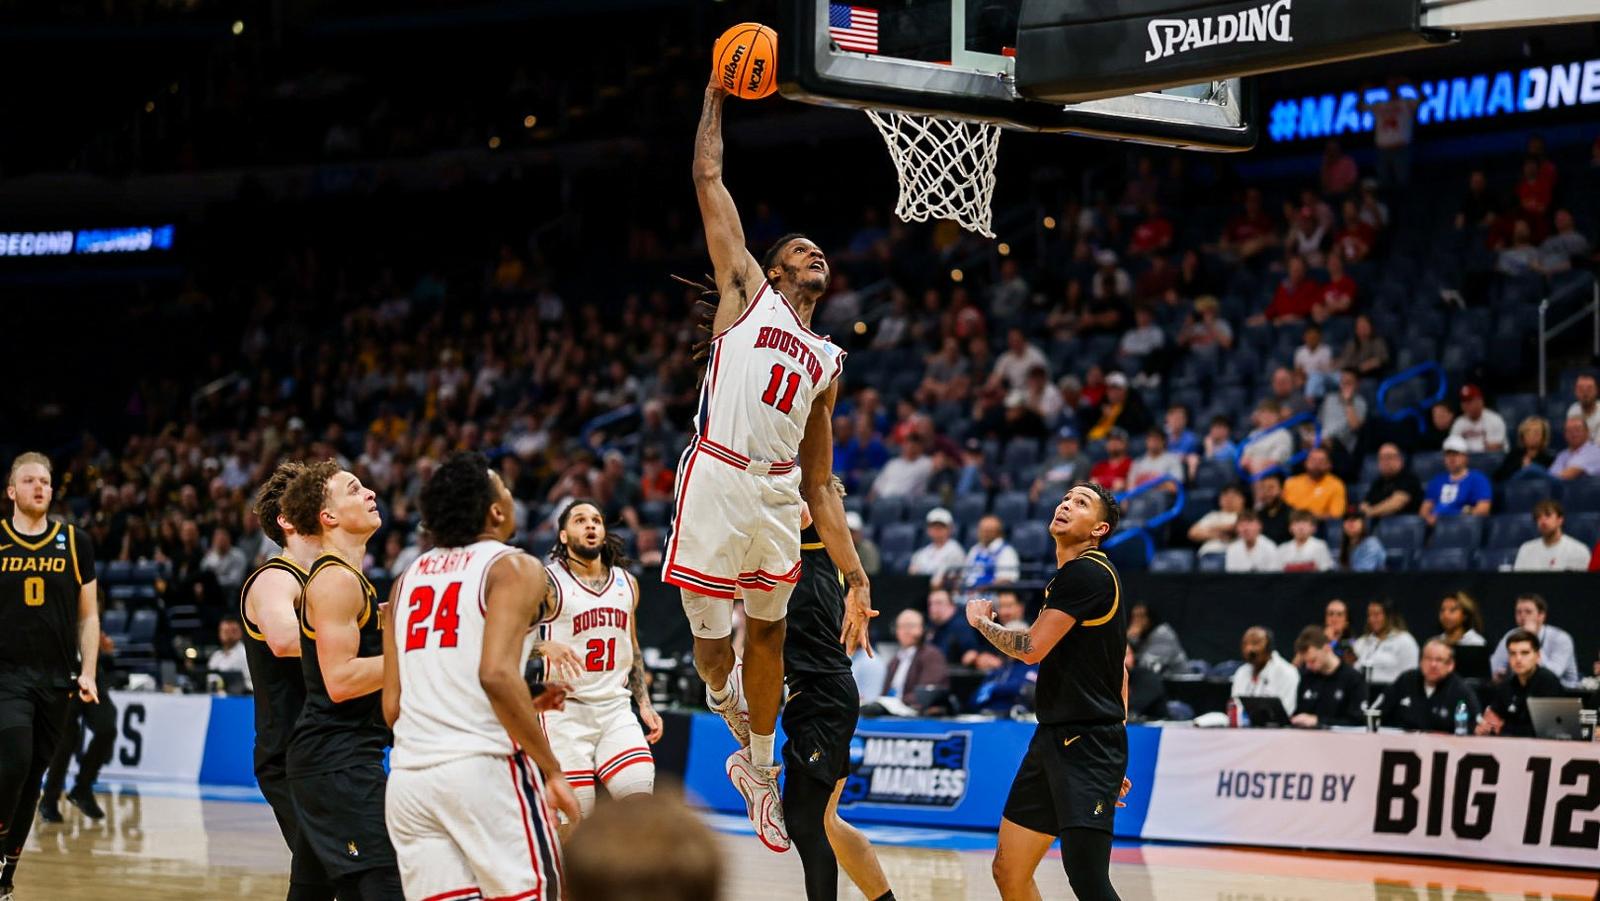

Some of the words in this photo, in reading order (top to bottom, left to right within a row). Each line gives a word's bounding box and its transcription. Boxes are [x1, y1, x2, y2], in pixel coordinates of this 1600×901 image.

[1145, 0, 1292, 62] SPALDING
[722, 45, 746, 89] Wilson
[747, 58, 765, 92] NCAA
[753, 326, 823, 389] HOUSTON
[761, 363, 801, 415] 11
[1, 556, 66, 573] IDAHO
[24, 576, 45, 606] 0
[405, 581, 462, 653] 24
[573, 607, 627, 637] HOUSTON
[585, 637, 616, 672] 21
[863, 737, 934, 767] MARCH
[870, 766, 966, 798] MADNESS
[1216, 769, 1313, 801] HOSTED
[1321, 774, 1356, 803] BY
[1373, 749, 1500, 841] BIG
[1522, 756, 1600, 850] 12
